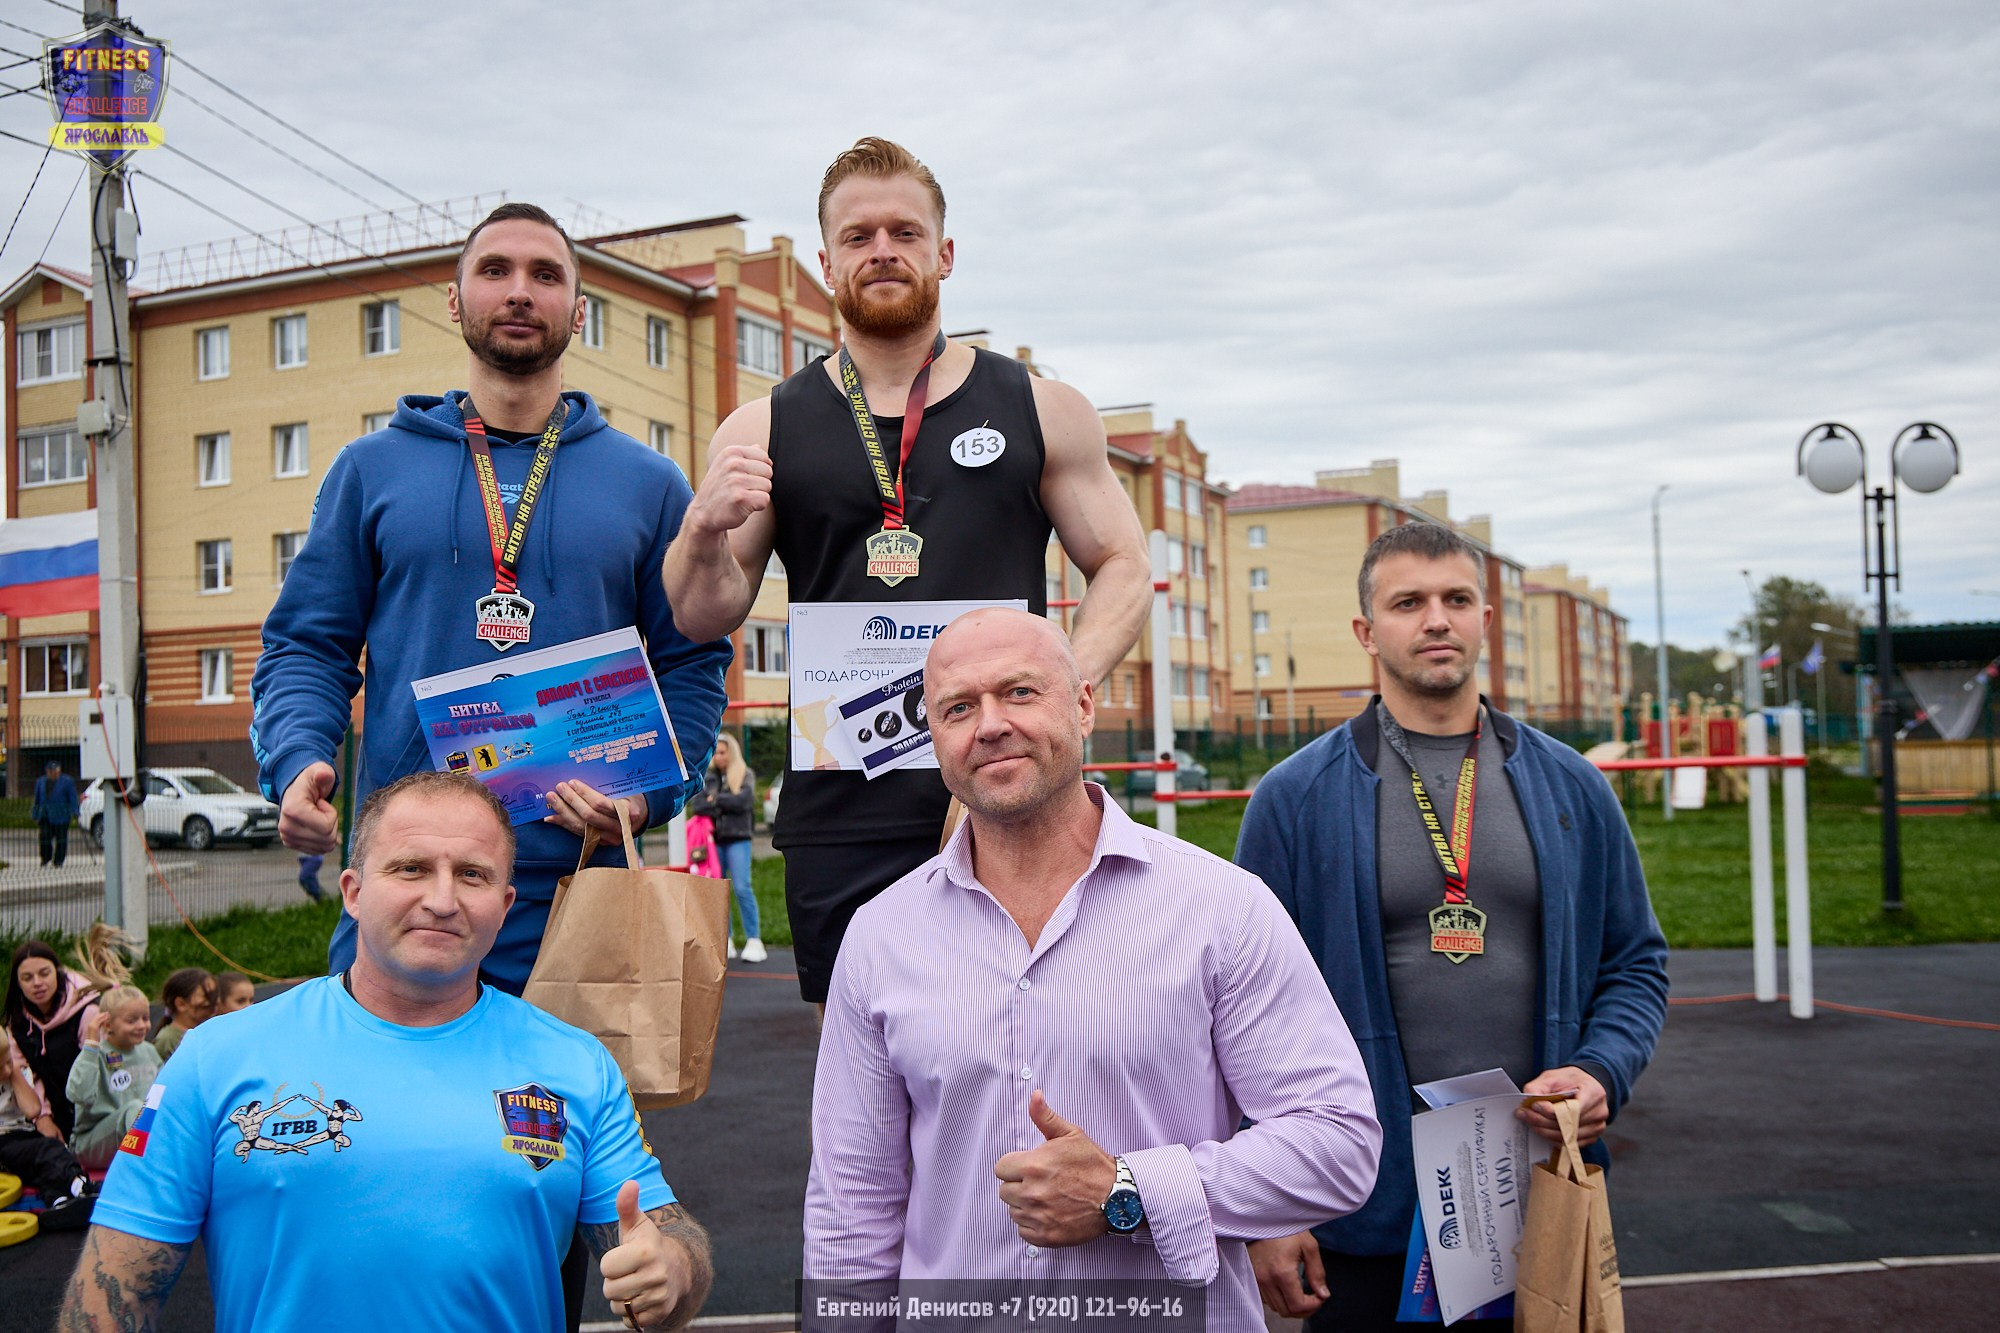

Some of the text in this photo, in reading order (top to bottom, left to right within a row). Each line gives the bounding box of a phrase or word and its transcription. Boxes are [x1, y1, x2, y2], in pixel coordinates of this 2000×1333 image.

[842, 363, 852, 376] 17
[846, 379, 858, 390] 24
[547, 425, 560, 435] 17
[850, 392, 896, 499] БИТВА НА СТРЕЛКЕ
[956, 435, 1000, 459] 153
[504, 452, 549, 563] БИТВА НА СТРЕЛКЕ
[870, 561, 917, 574] CHALLENGE
[484, 617, 524, 625] FITNESS
[479, 625, 528, 640] CHALLENGE
[804, 669, 894, 683] ПОДАРОЧН
[881, 674, 921, 697] Protein
[448, 701, 504, 718] БИТВА
[1423, 813, 1440, 830] НА
[1430, 833, 1459, 874] БИТВА
[1434, 937, 1481, 951] CHALLENGE
[507, 1094, 557, 1113] FITNESS
[272, 1120, 318, 1136] IFBB
[512, 1121, 560, 1138] CHALLENGE
[512, 1139, 559, 1157] ЯРОСЛАВЛЬ
[1474, 1106, 1504, 1286] ПОДАРОЧНЫЙ СЕРТИФИКАТ
